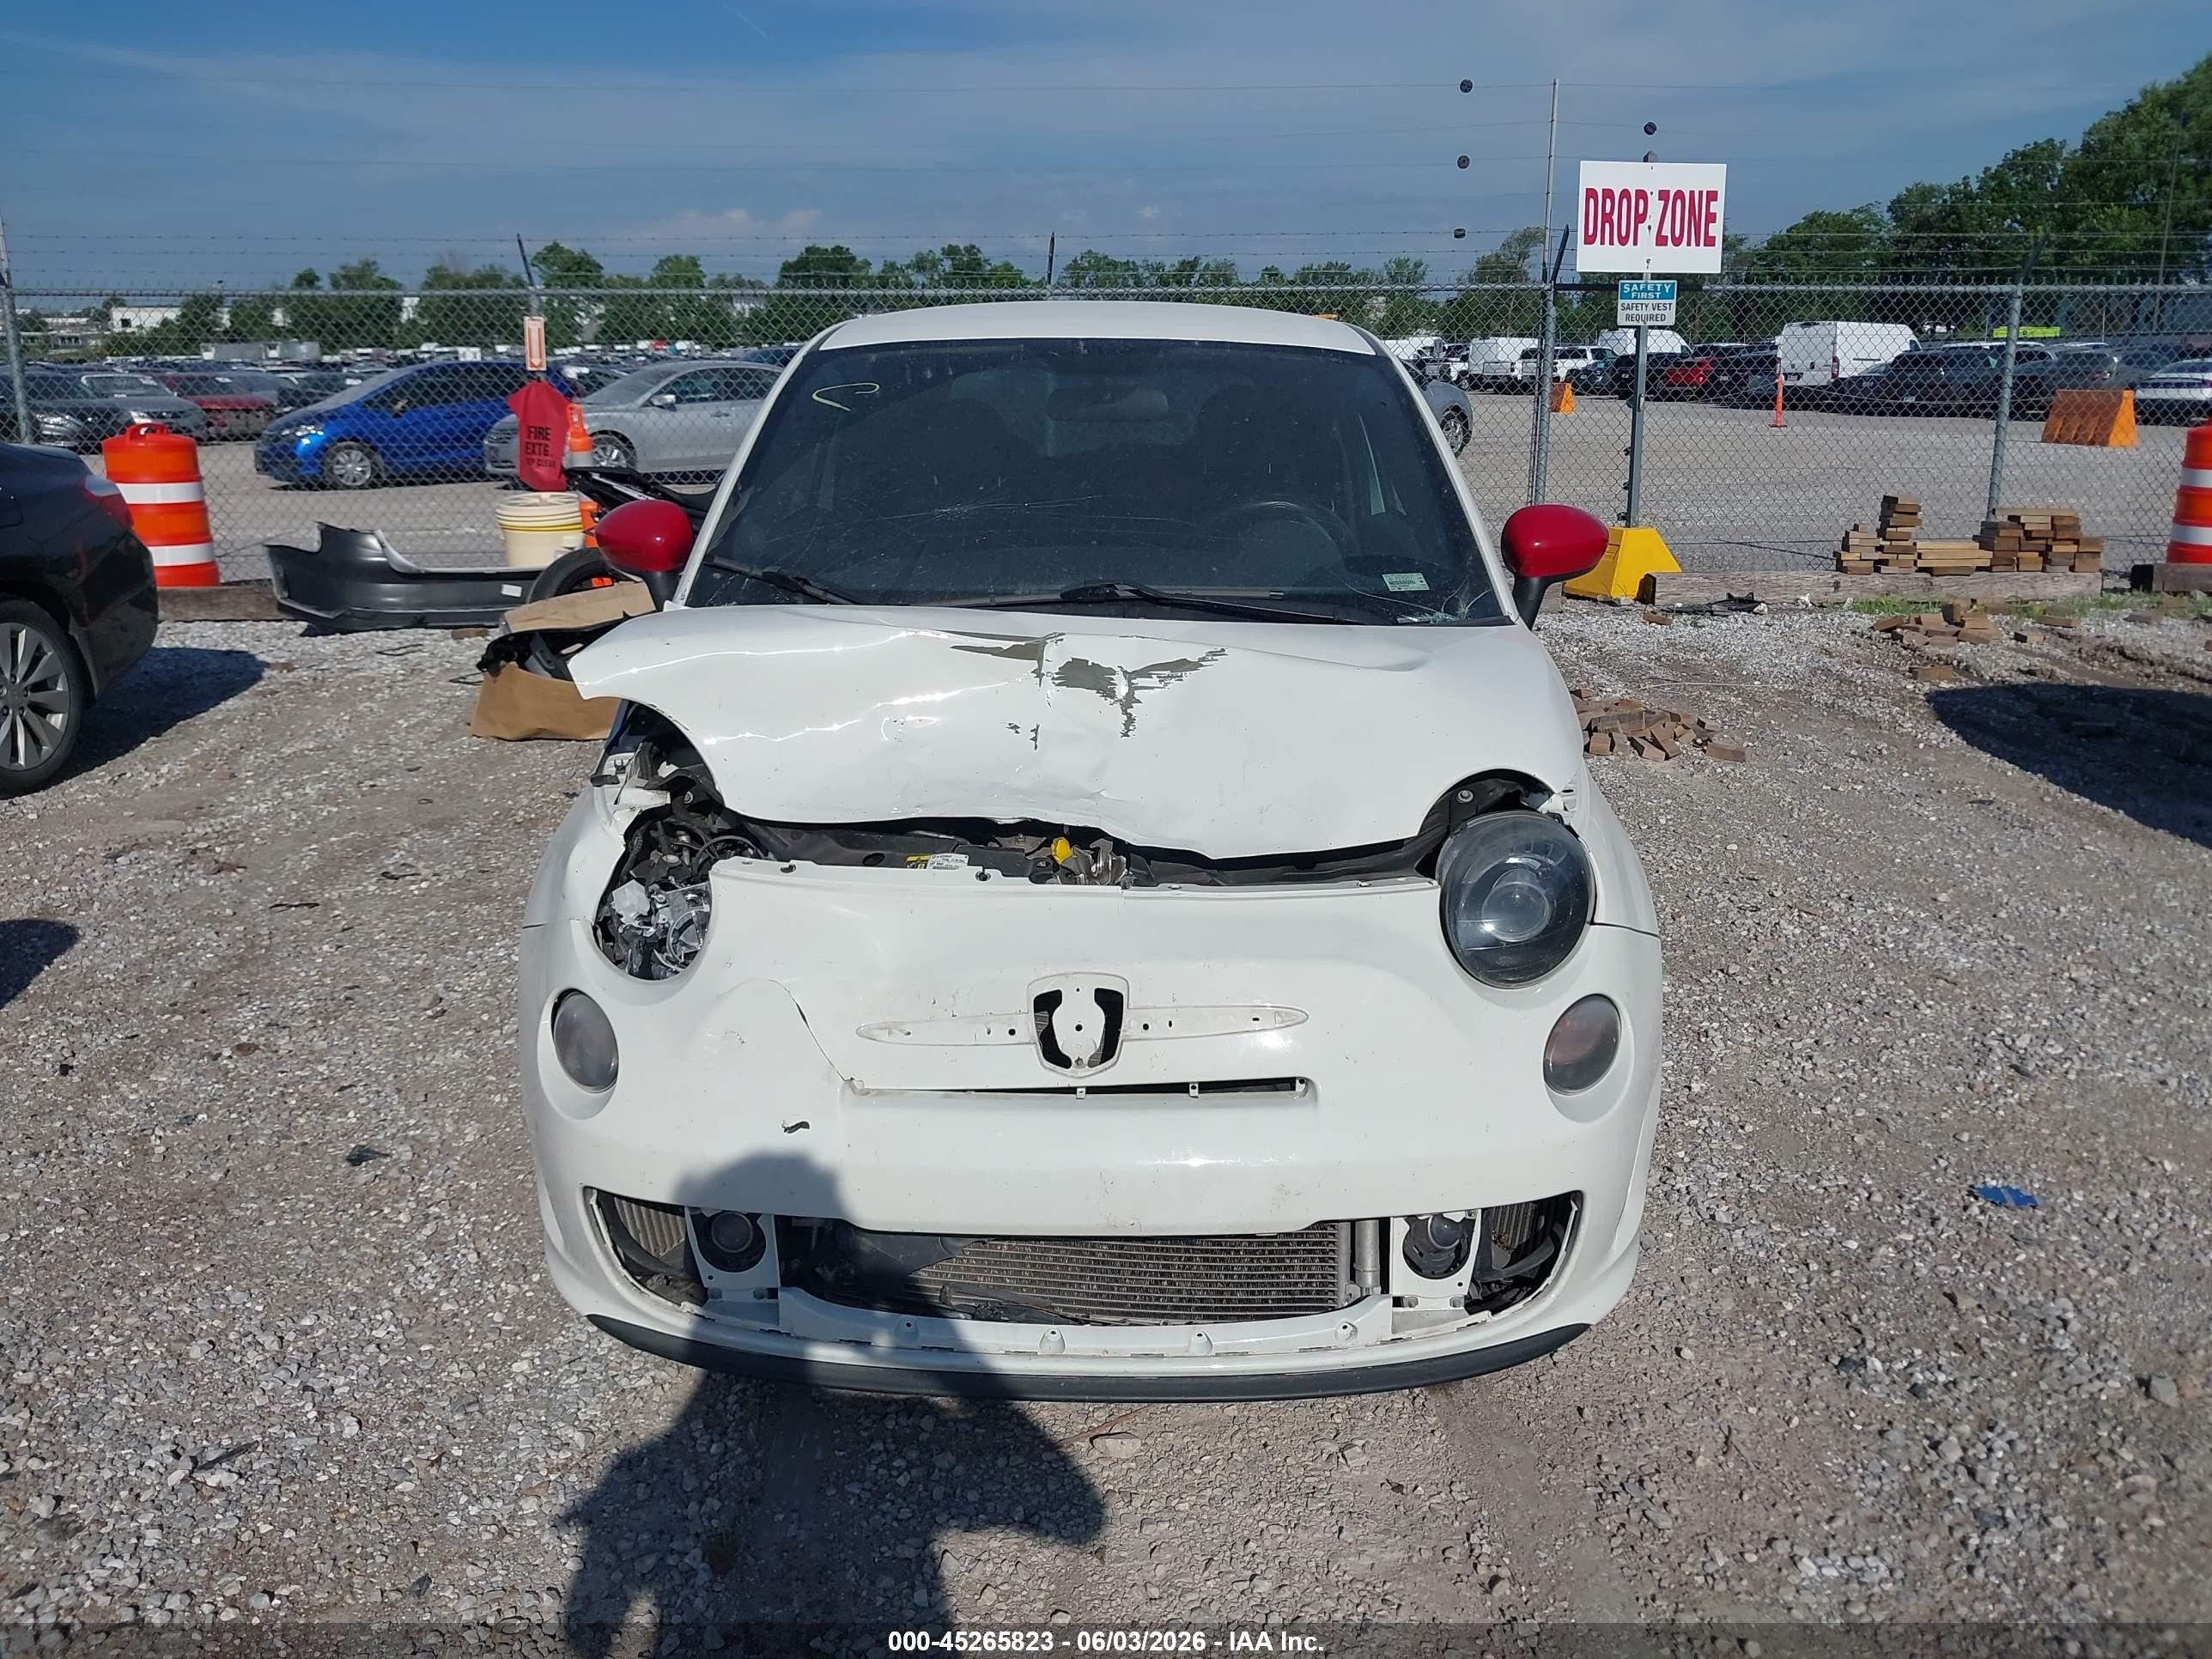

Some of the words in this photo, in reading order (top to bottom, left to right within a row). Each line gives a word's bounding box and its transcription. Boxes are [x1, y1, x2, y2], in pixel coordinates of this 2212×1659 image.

[1583, 187, 1649, 246] DROP
[1655, 189, 1718, 247] ZONE
[1623, 283, 1671, 294] SAFETY
[1620, 302, 1649, 311] SAFETY
[1651, 302, 1673, 311] VEST
[1625, 313, 1666, 323] REQUIRED
[528, 426, 551, 441] FIRE
[525, 441, 554, 458] EXTG.
